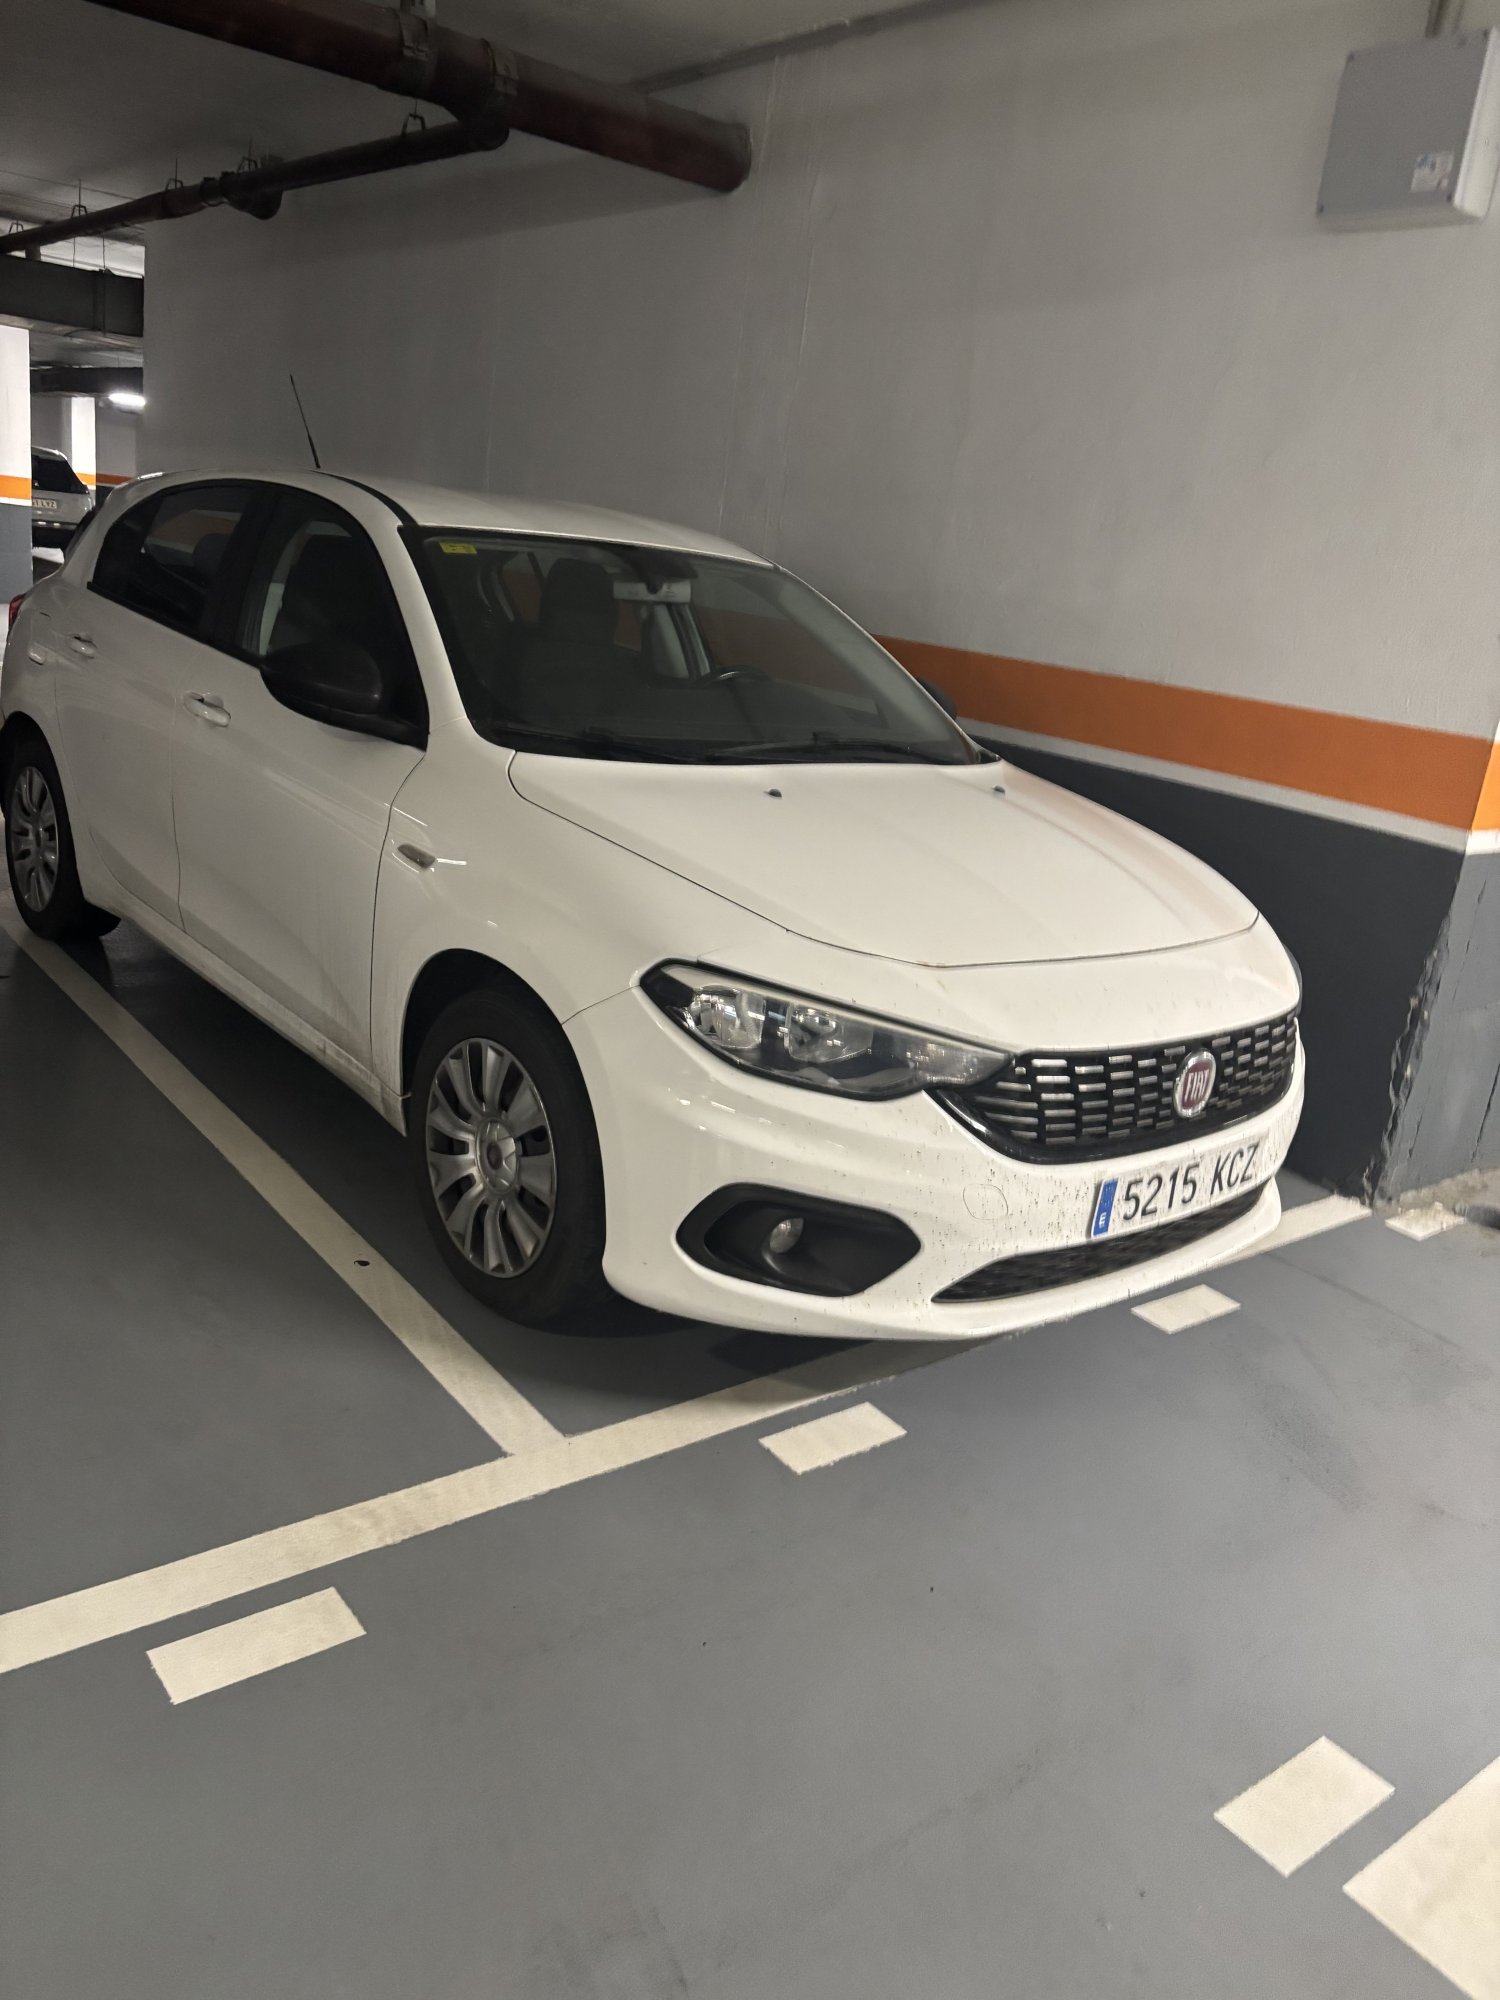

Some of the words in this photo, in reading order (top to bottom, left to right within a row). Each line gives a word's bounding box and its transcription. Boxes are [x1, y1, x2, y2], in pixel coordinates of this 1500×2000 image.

[1184, 1069, 1210, 1102] FIAT
[1123, 1162, 1200, 1221] 5215
[1209, 1142, 1260, 1196] KCZ
[1098, 1212, 1107, 1228] E
